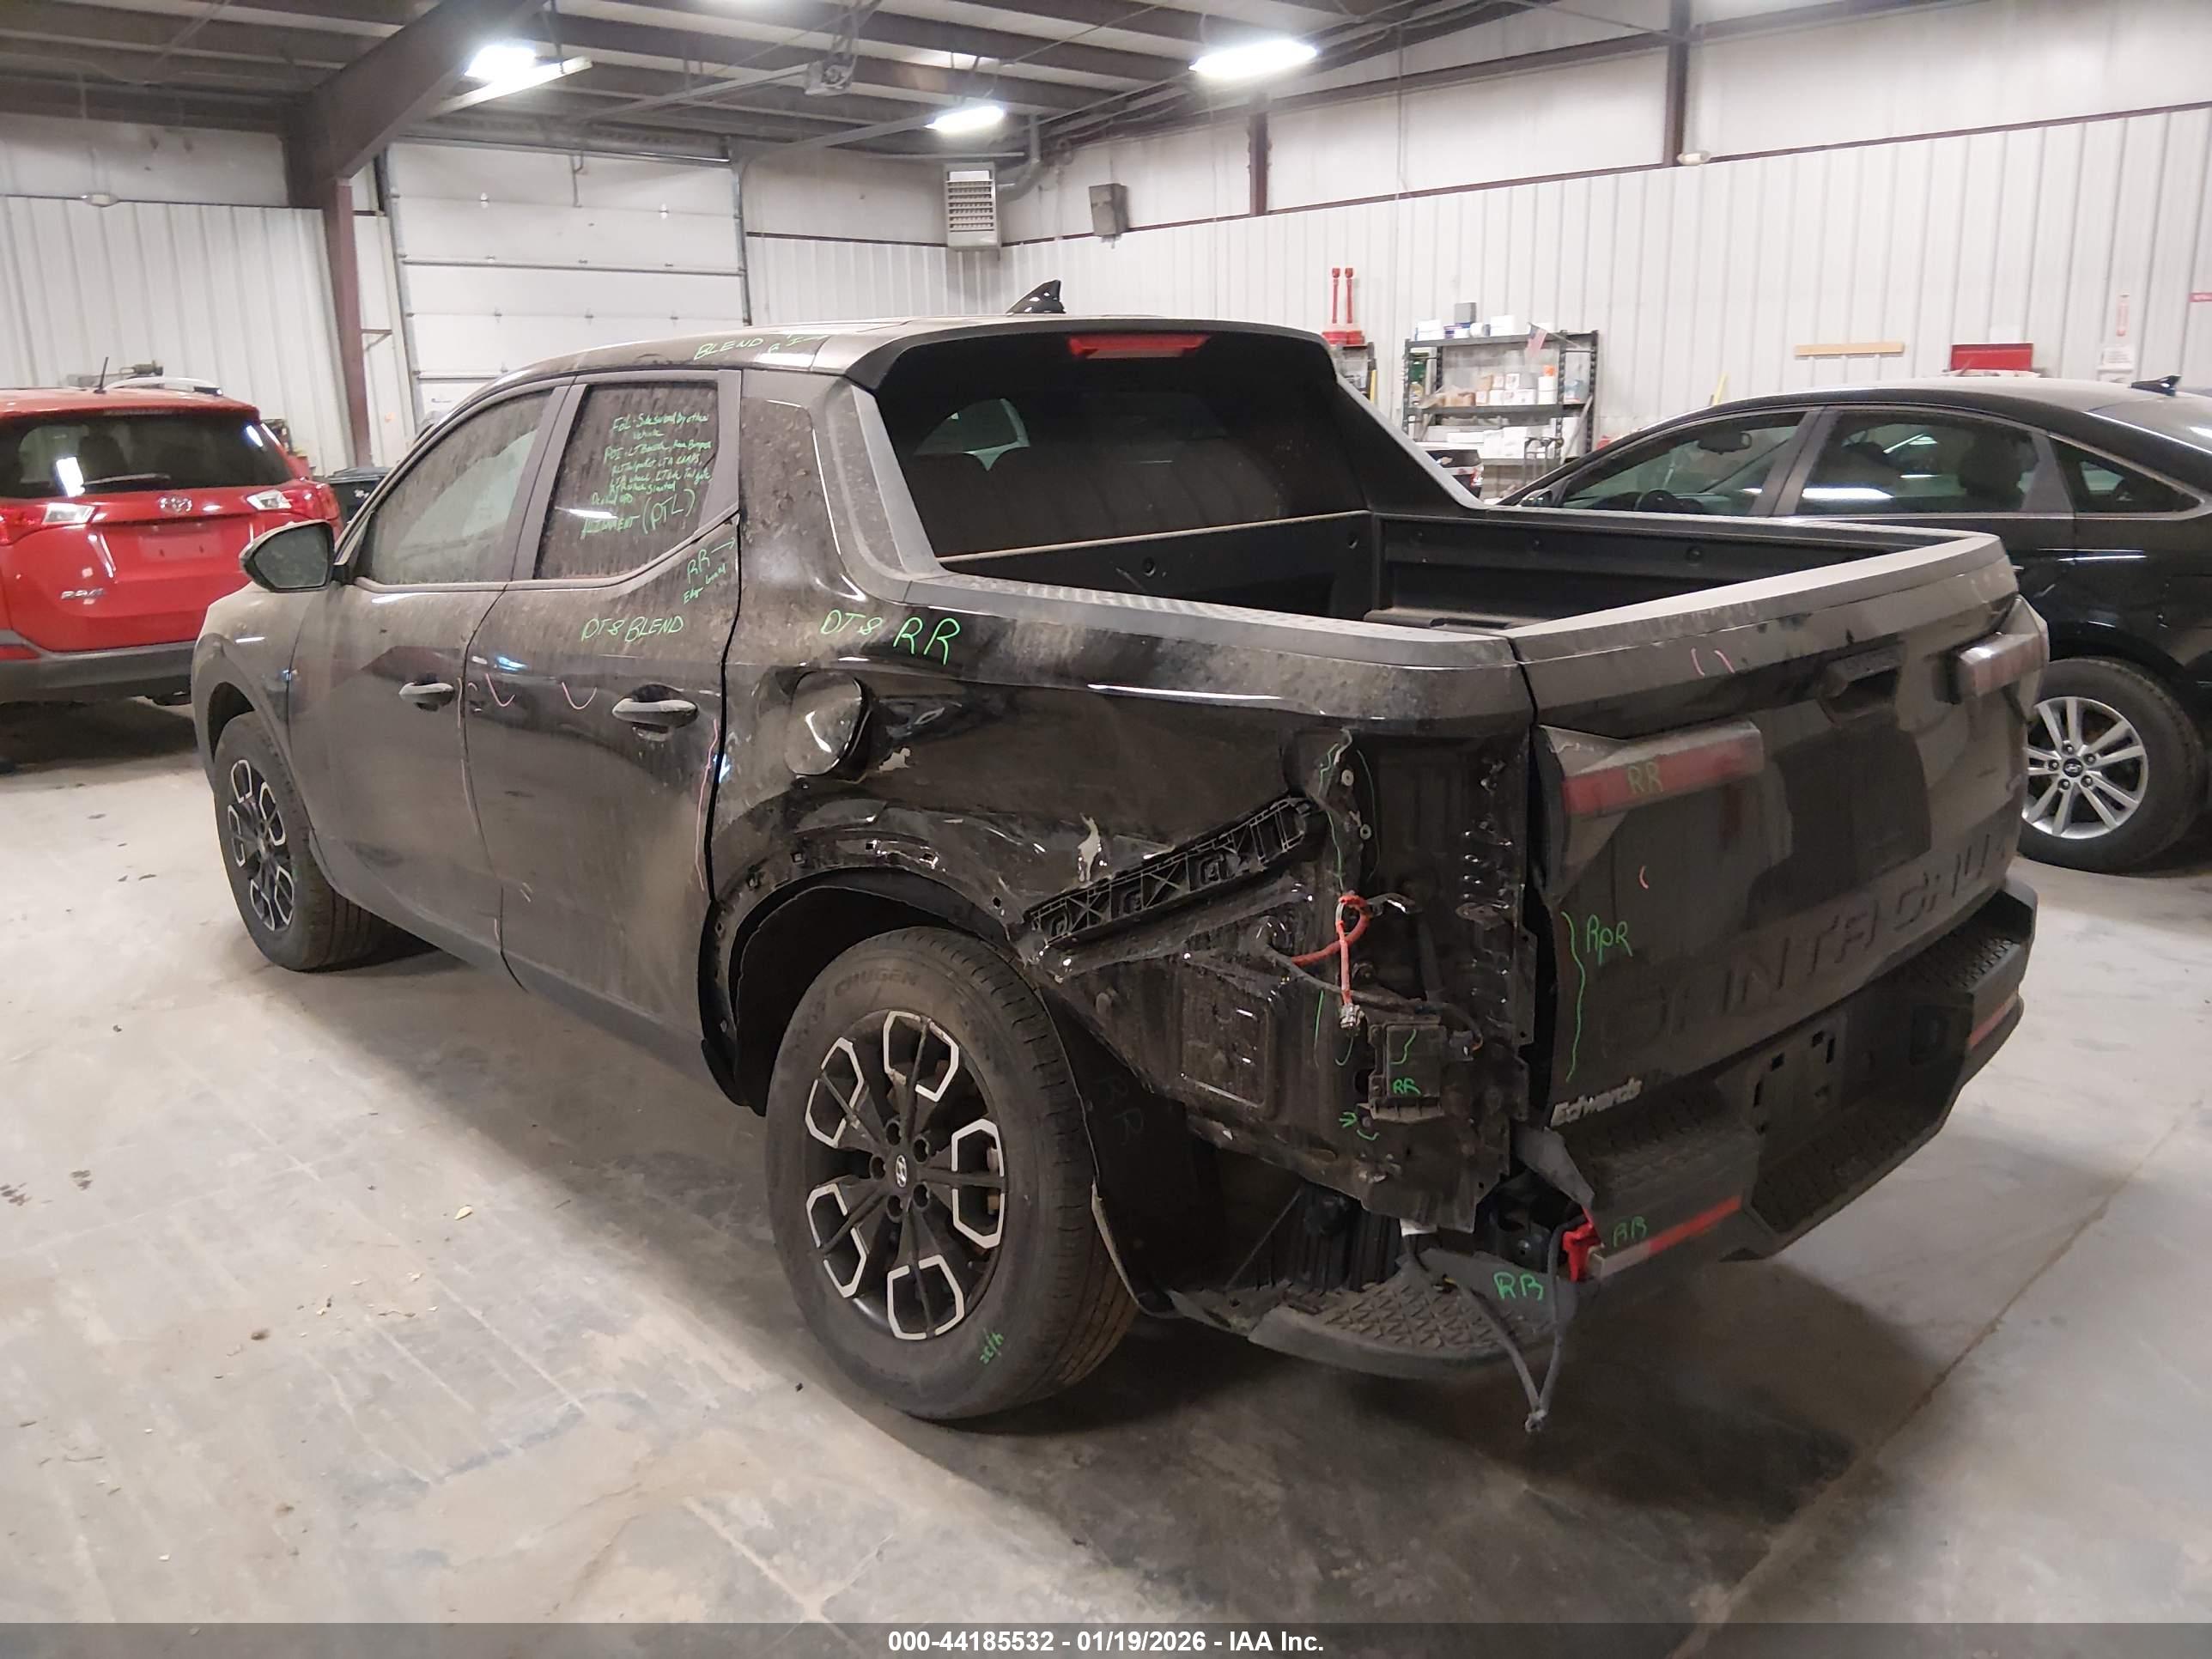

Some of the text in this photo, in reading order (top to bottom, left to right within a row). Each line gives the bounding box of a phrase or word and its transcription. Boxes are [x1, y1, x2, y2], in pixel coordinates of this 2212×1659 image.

[693, 338, 764, 360] BLEND
[687, 549, 711, 585] RR
[624, 616, 684, 642] BLEND
[892, 617, 961, 666] RR
[1627, 761, 1664, 795] RR
[1393, 1078, 1422, 1095] RR
